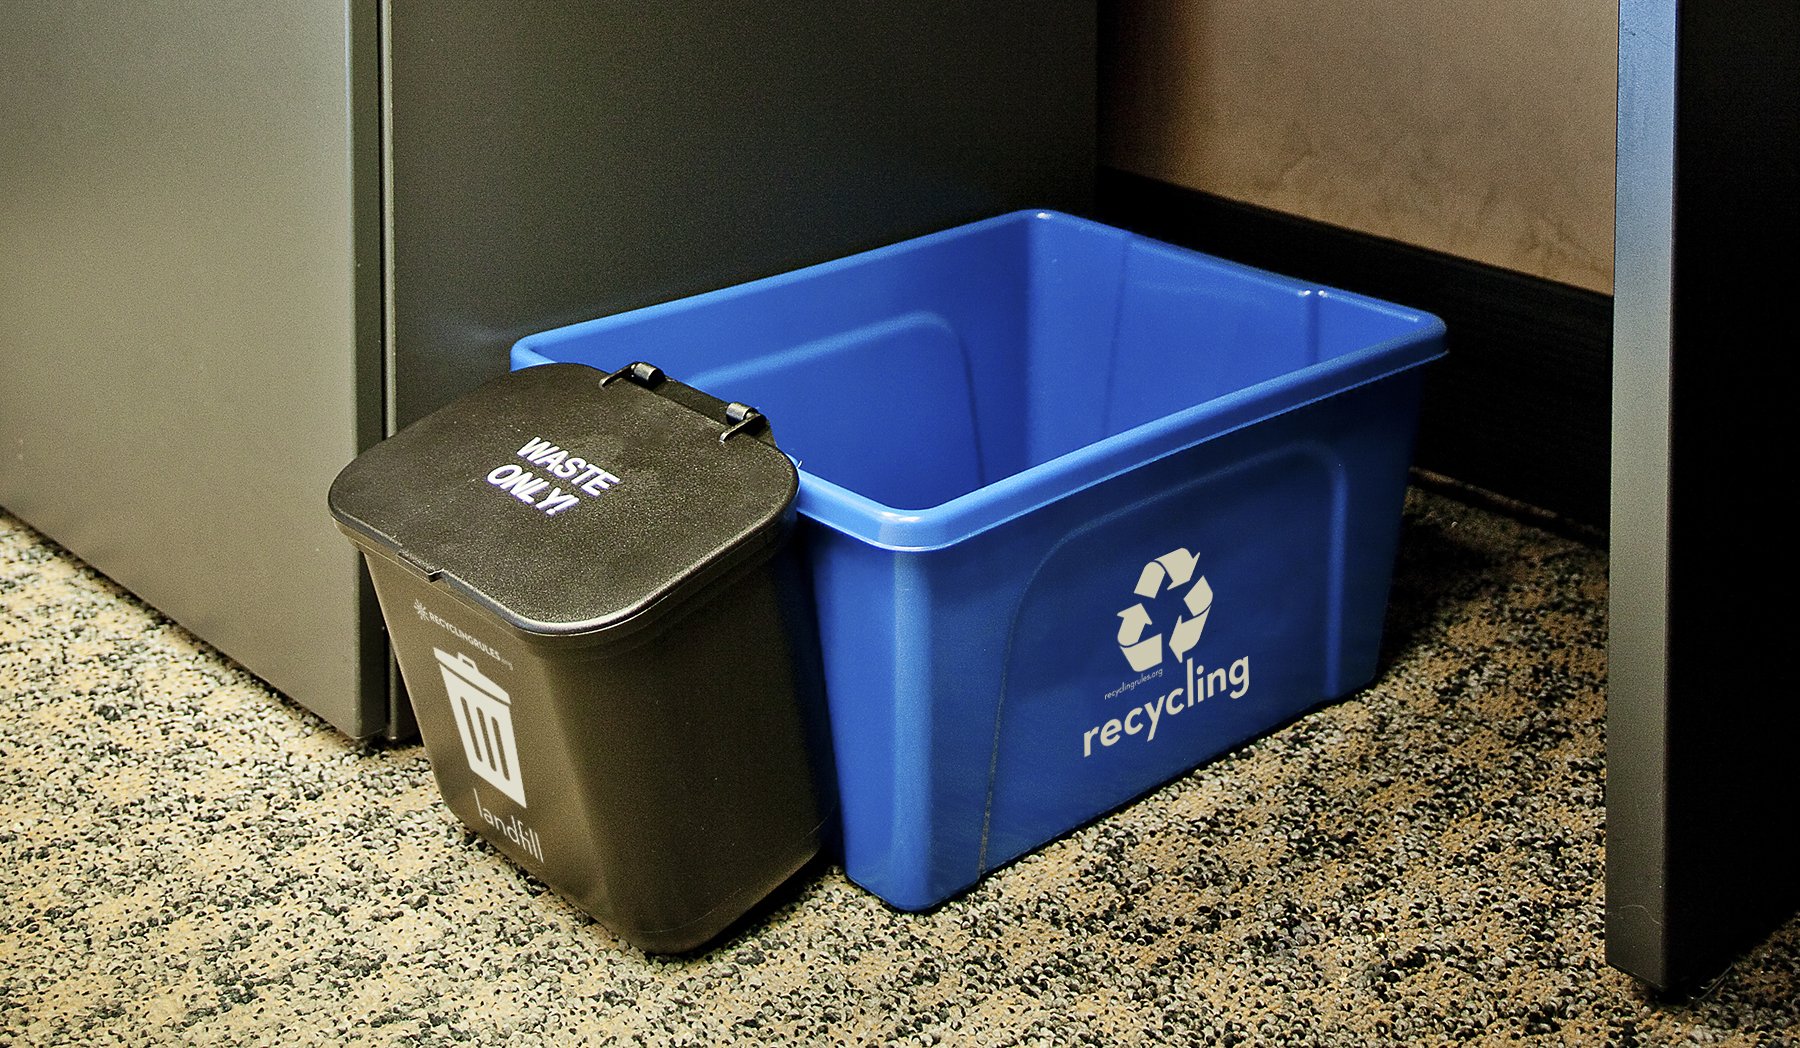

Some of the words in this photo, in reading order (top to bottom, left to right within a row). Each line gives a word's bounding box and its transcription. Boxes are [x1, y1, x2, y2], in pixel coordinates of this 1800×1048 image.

[486, 464, 580, 515] ONLY!
[516, 436, 620, 497] WASTE
[1083, 655, 1250, 758] recycling
[1104, 668, 1163, 700] recyclingrules.org
[473, 788, 544, 864] landfill
